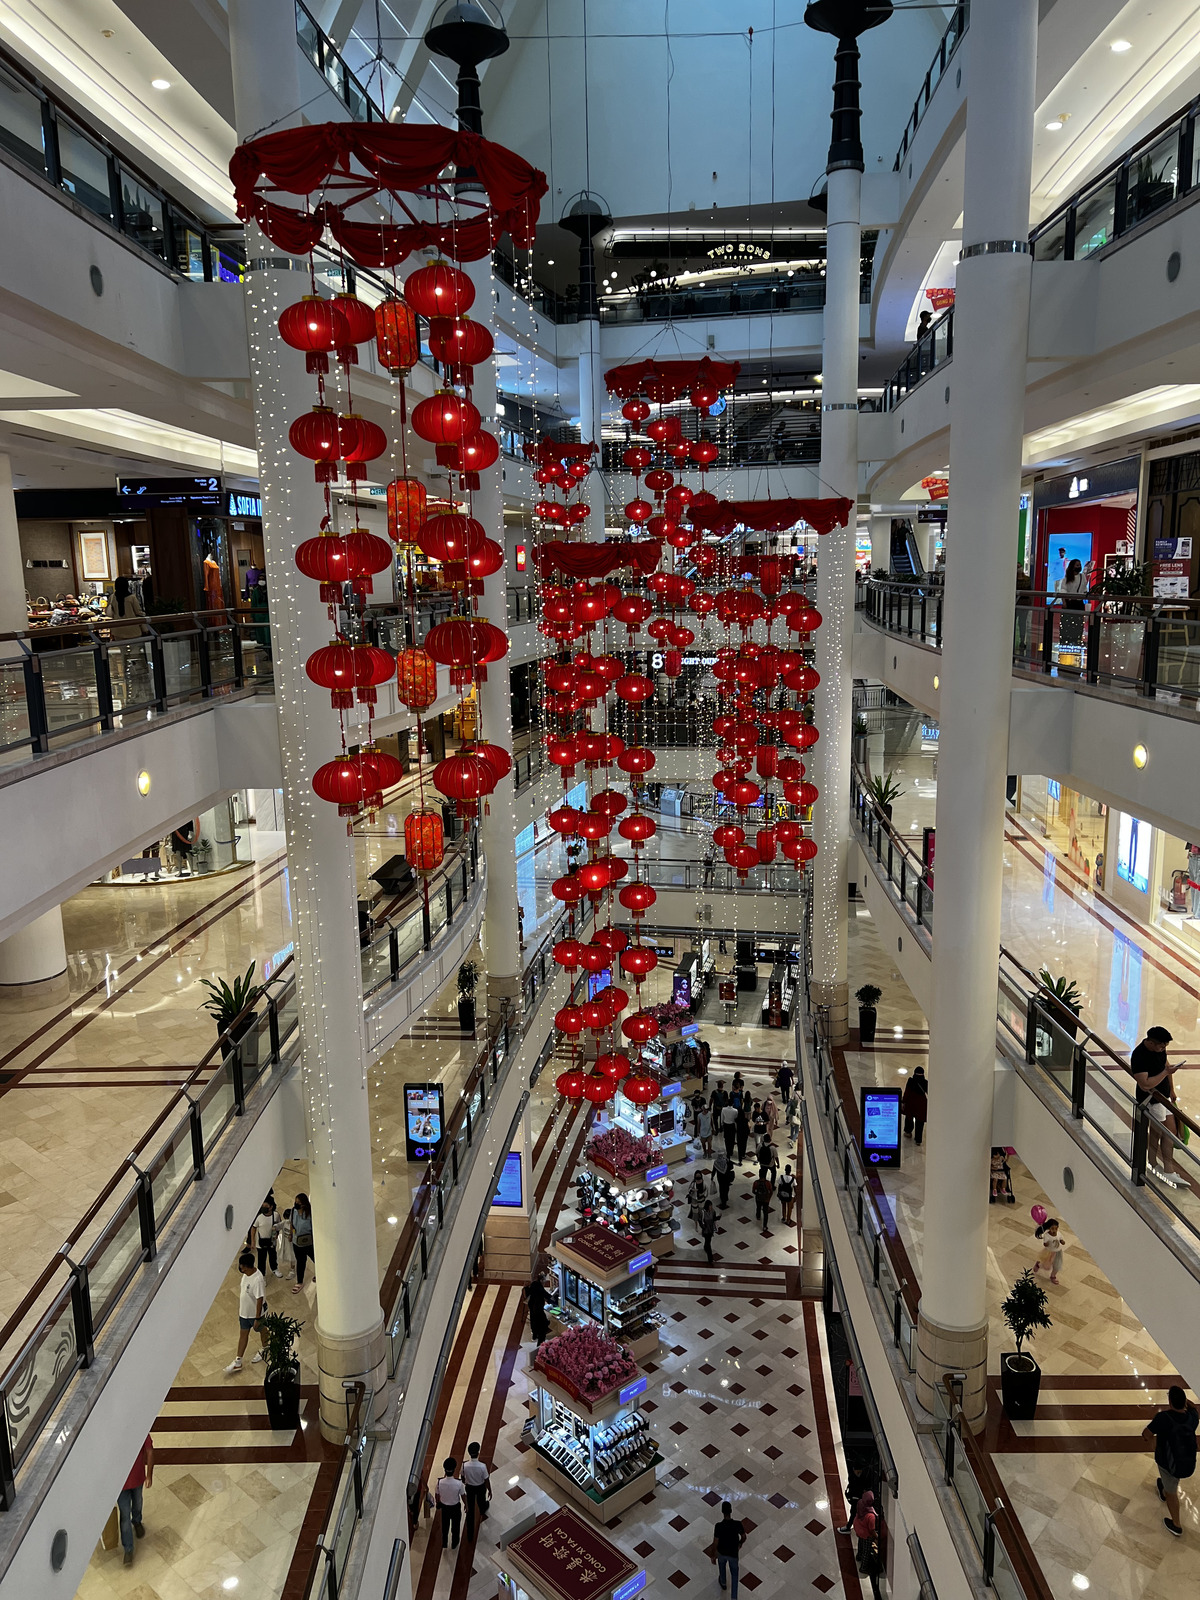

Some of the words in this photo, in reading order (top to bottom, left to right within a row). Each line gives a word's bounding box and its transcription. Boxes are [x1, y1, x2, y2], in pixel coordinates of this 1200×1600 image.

[707, 244, 734, 259] TWO
[738, 243, 771, 260] SONS
[208, 478, 218, 491] 2
[237, 495, 257, 516] SOFIA
[681, 657, 700, 665] IGHT
[577, 1237, 592, 1248] GONG
[597, 1248, 605, 1256] FA
[553, 1527, 568, 1540] CAI
[567, 1537, 579, 1549] FA
[575, 1546, 587, 1555] XI
[538, 1533, 598, 1584] 恭喜發財
[583, 1552, 607, 1573] GONG
